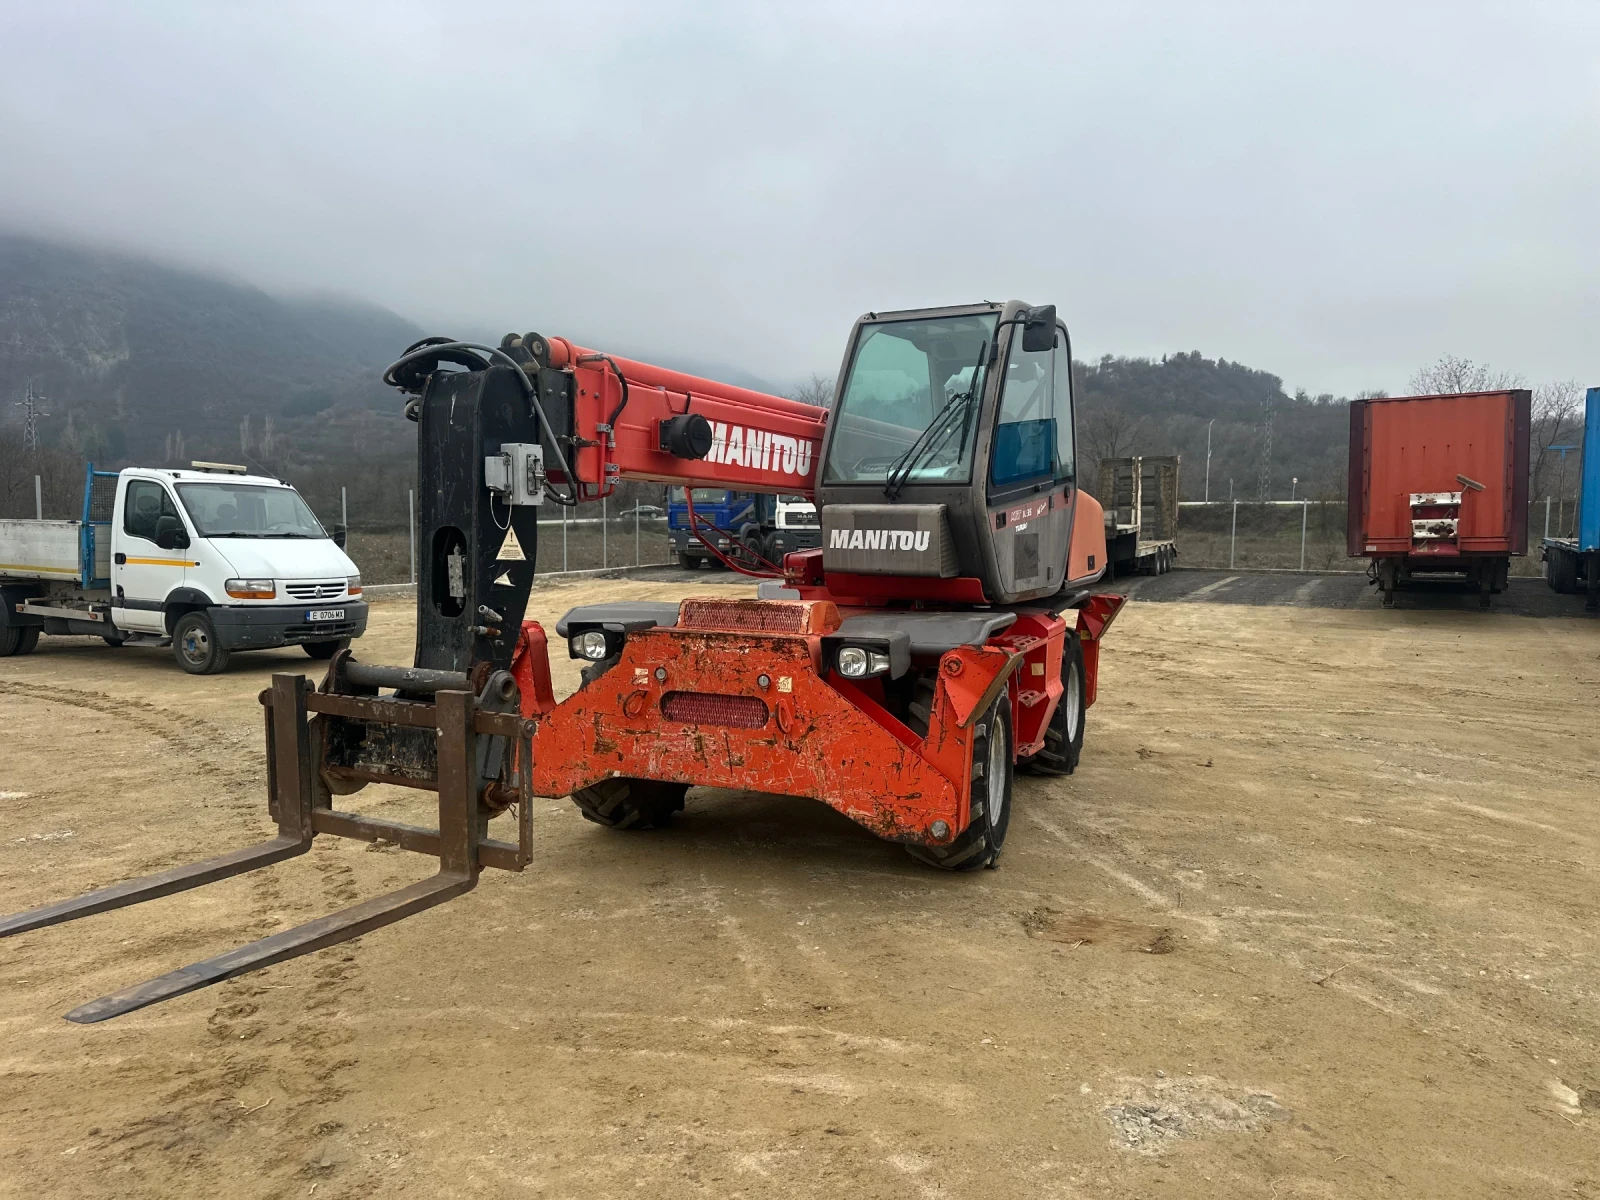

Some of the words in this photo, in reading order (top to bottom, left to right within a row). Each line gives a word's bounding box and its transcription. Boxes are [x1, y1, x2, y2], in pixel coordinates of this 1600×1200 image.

[703, 420, 812, 477] MANITOU
[830, 529, 930, 551] MANITOU
[320, 611, 335, 619] 0706
